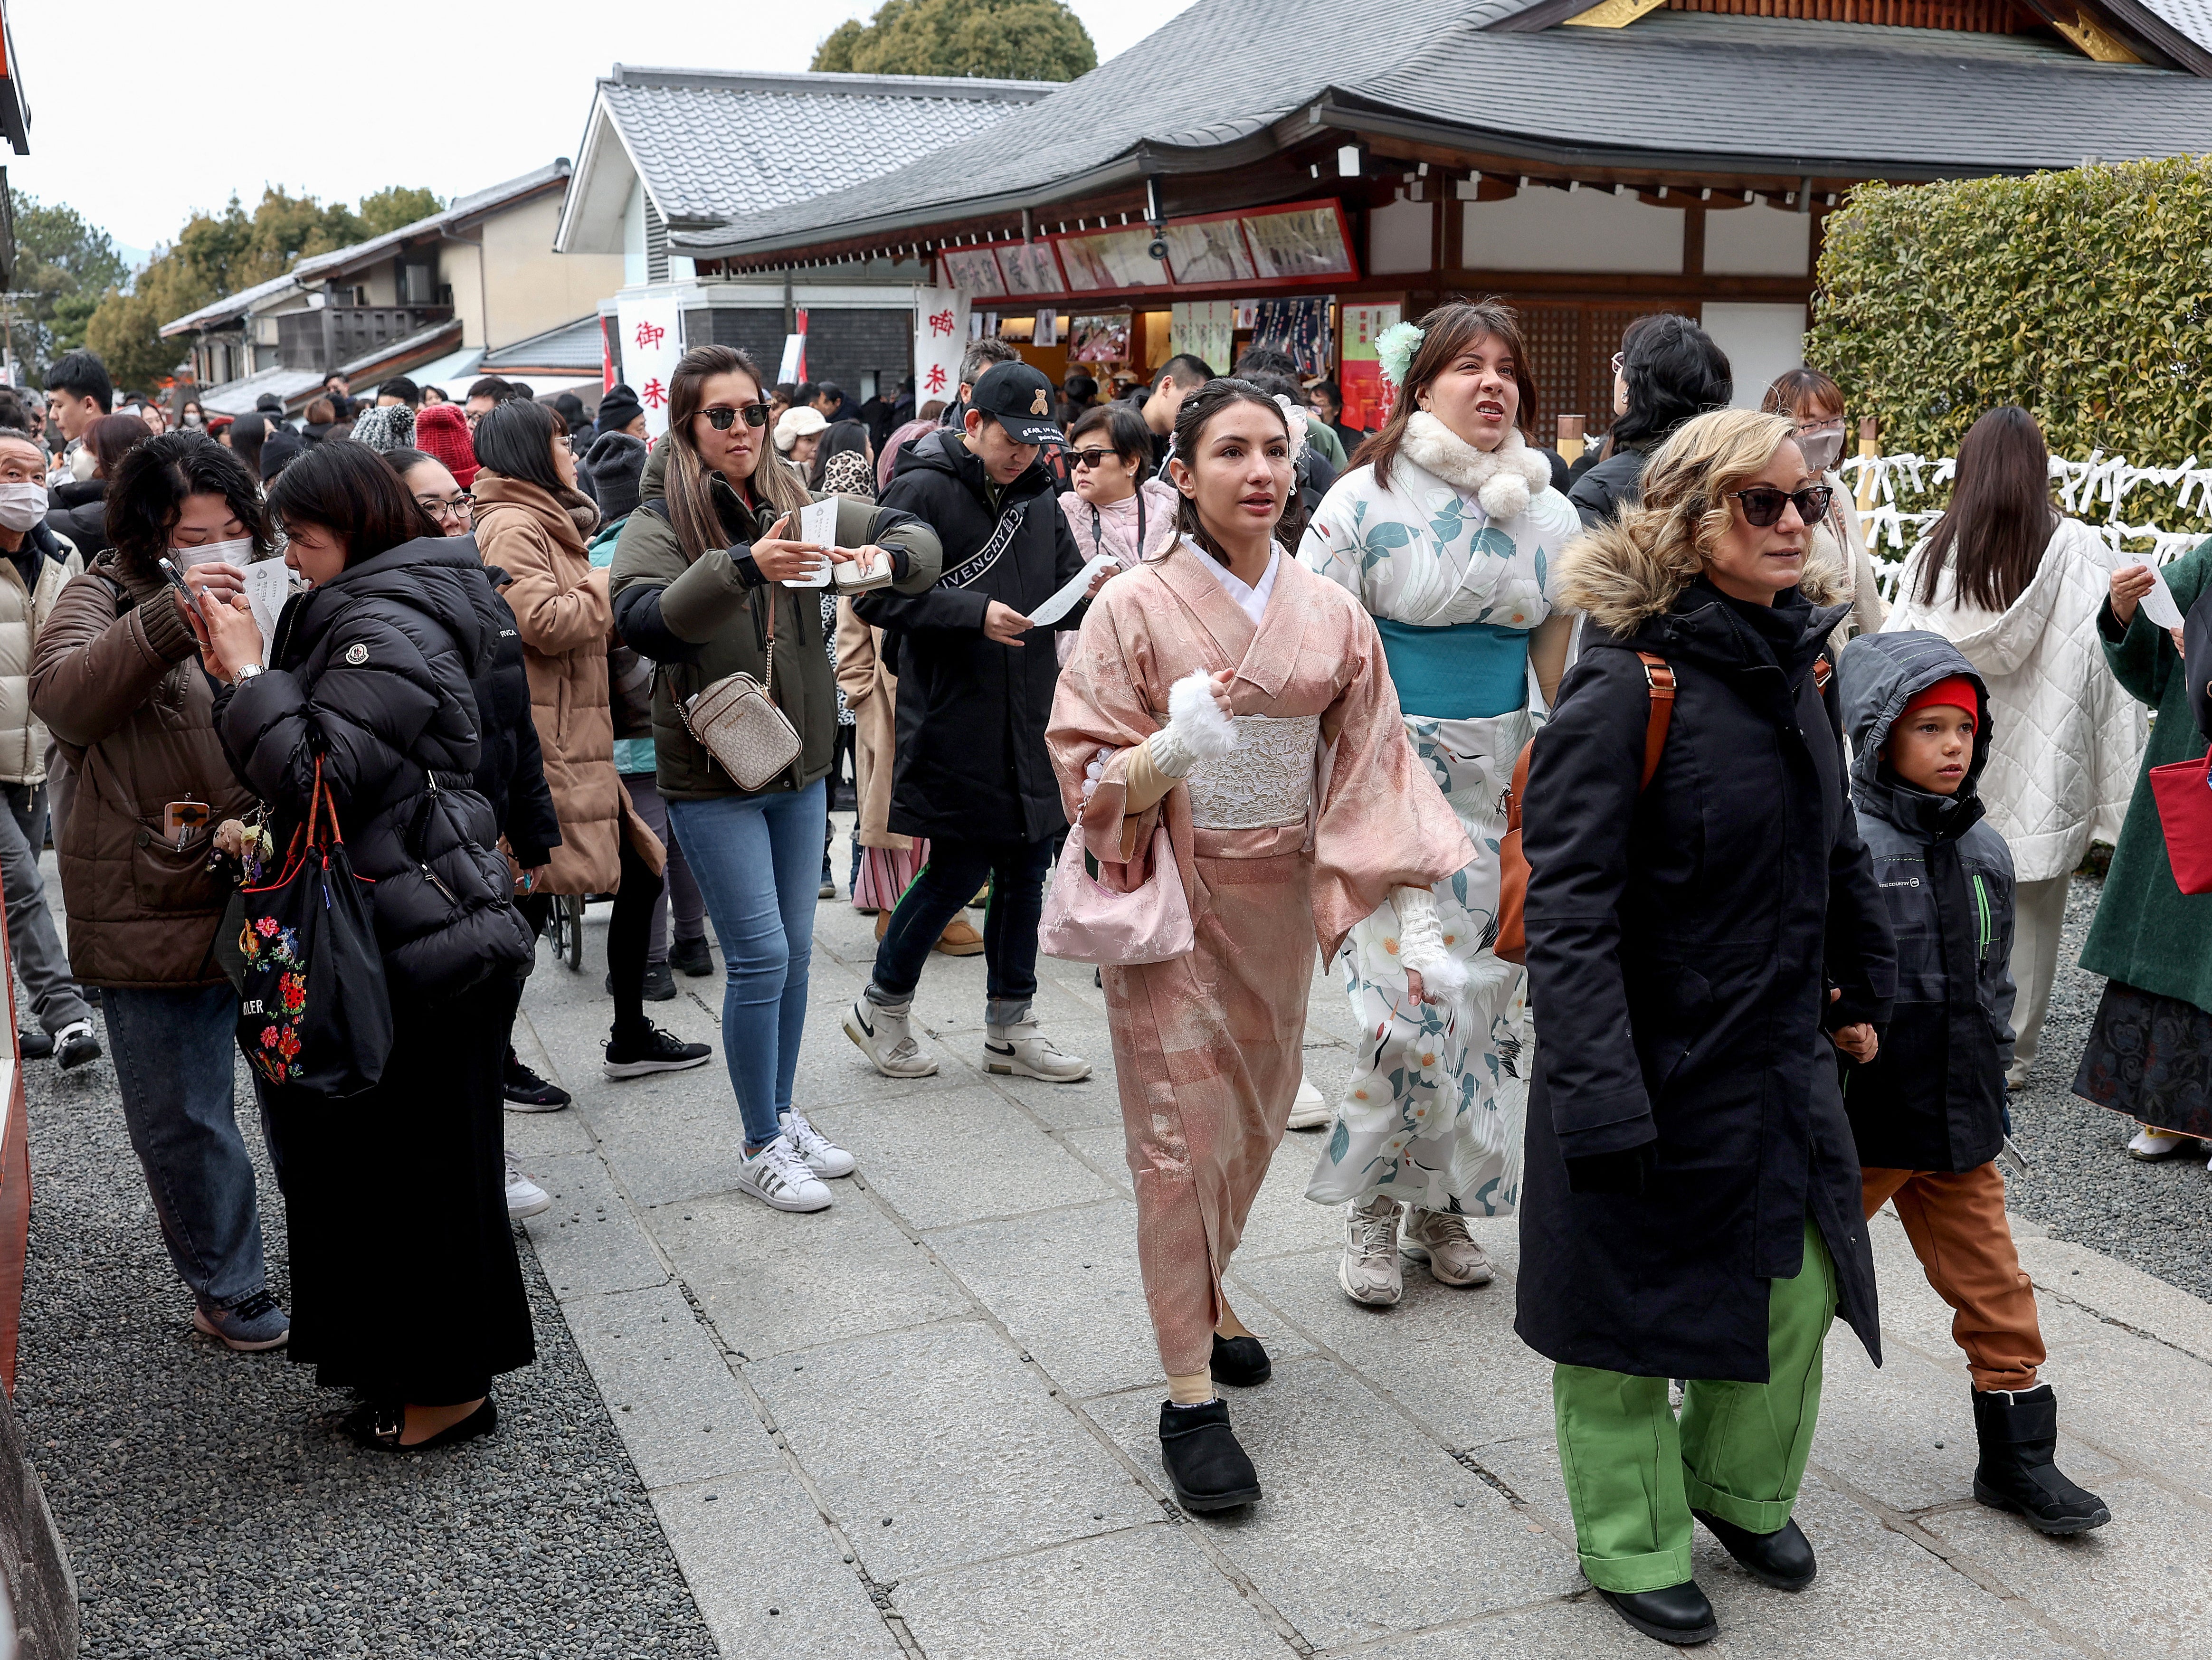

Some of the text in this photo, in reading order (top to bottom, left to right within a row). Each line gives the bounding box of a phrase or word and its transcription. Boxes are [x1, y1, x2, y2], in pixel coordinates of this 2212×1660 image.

[1022, 427, 1043, 436] BEAR
[936, 529, 1006, 589] IVENCHY
[500, 629, 517, 638] RVCA
